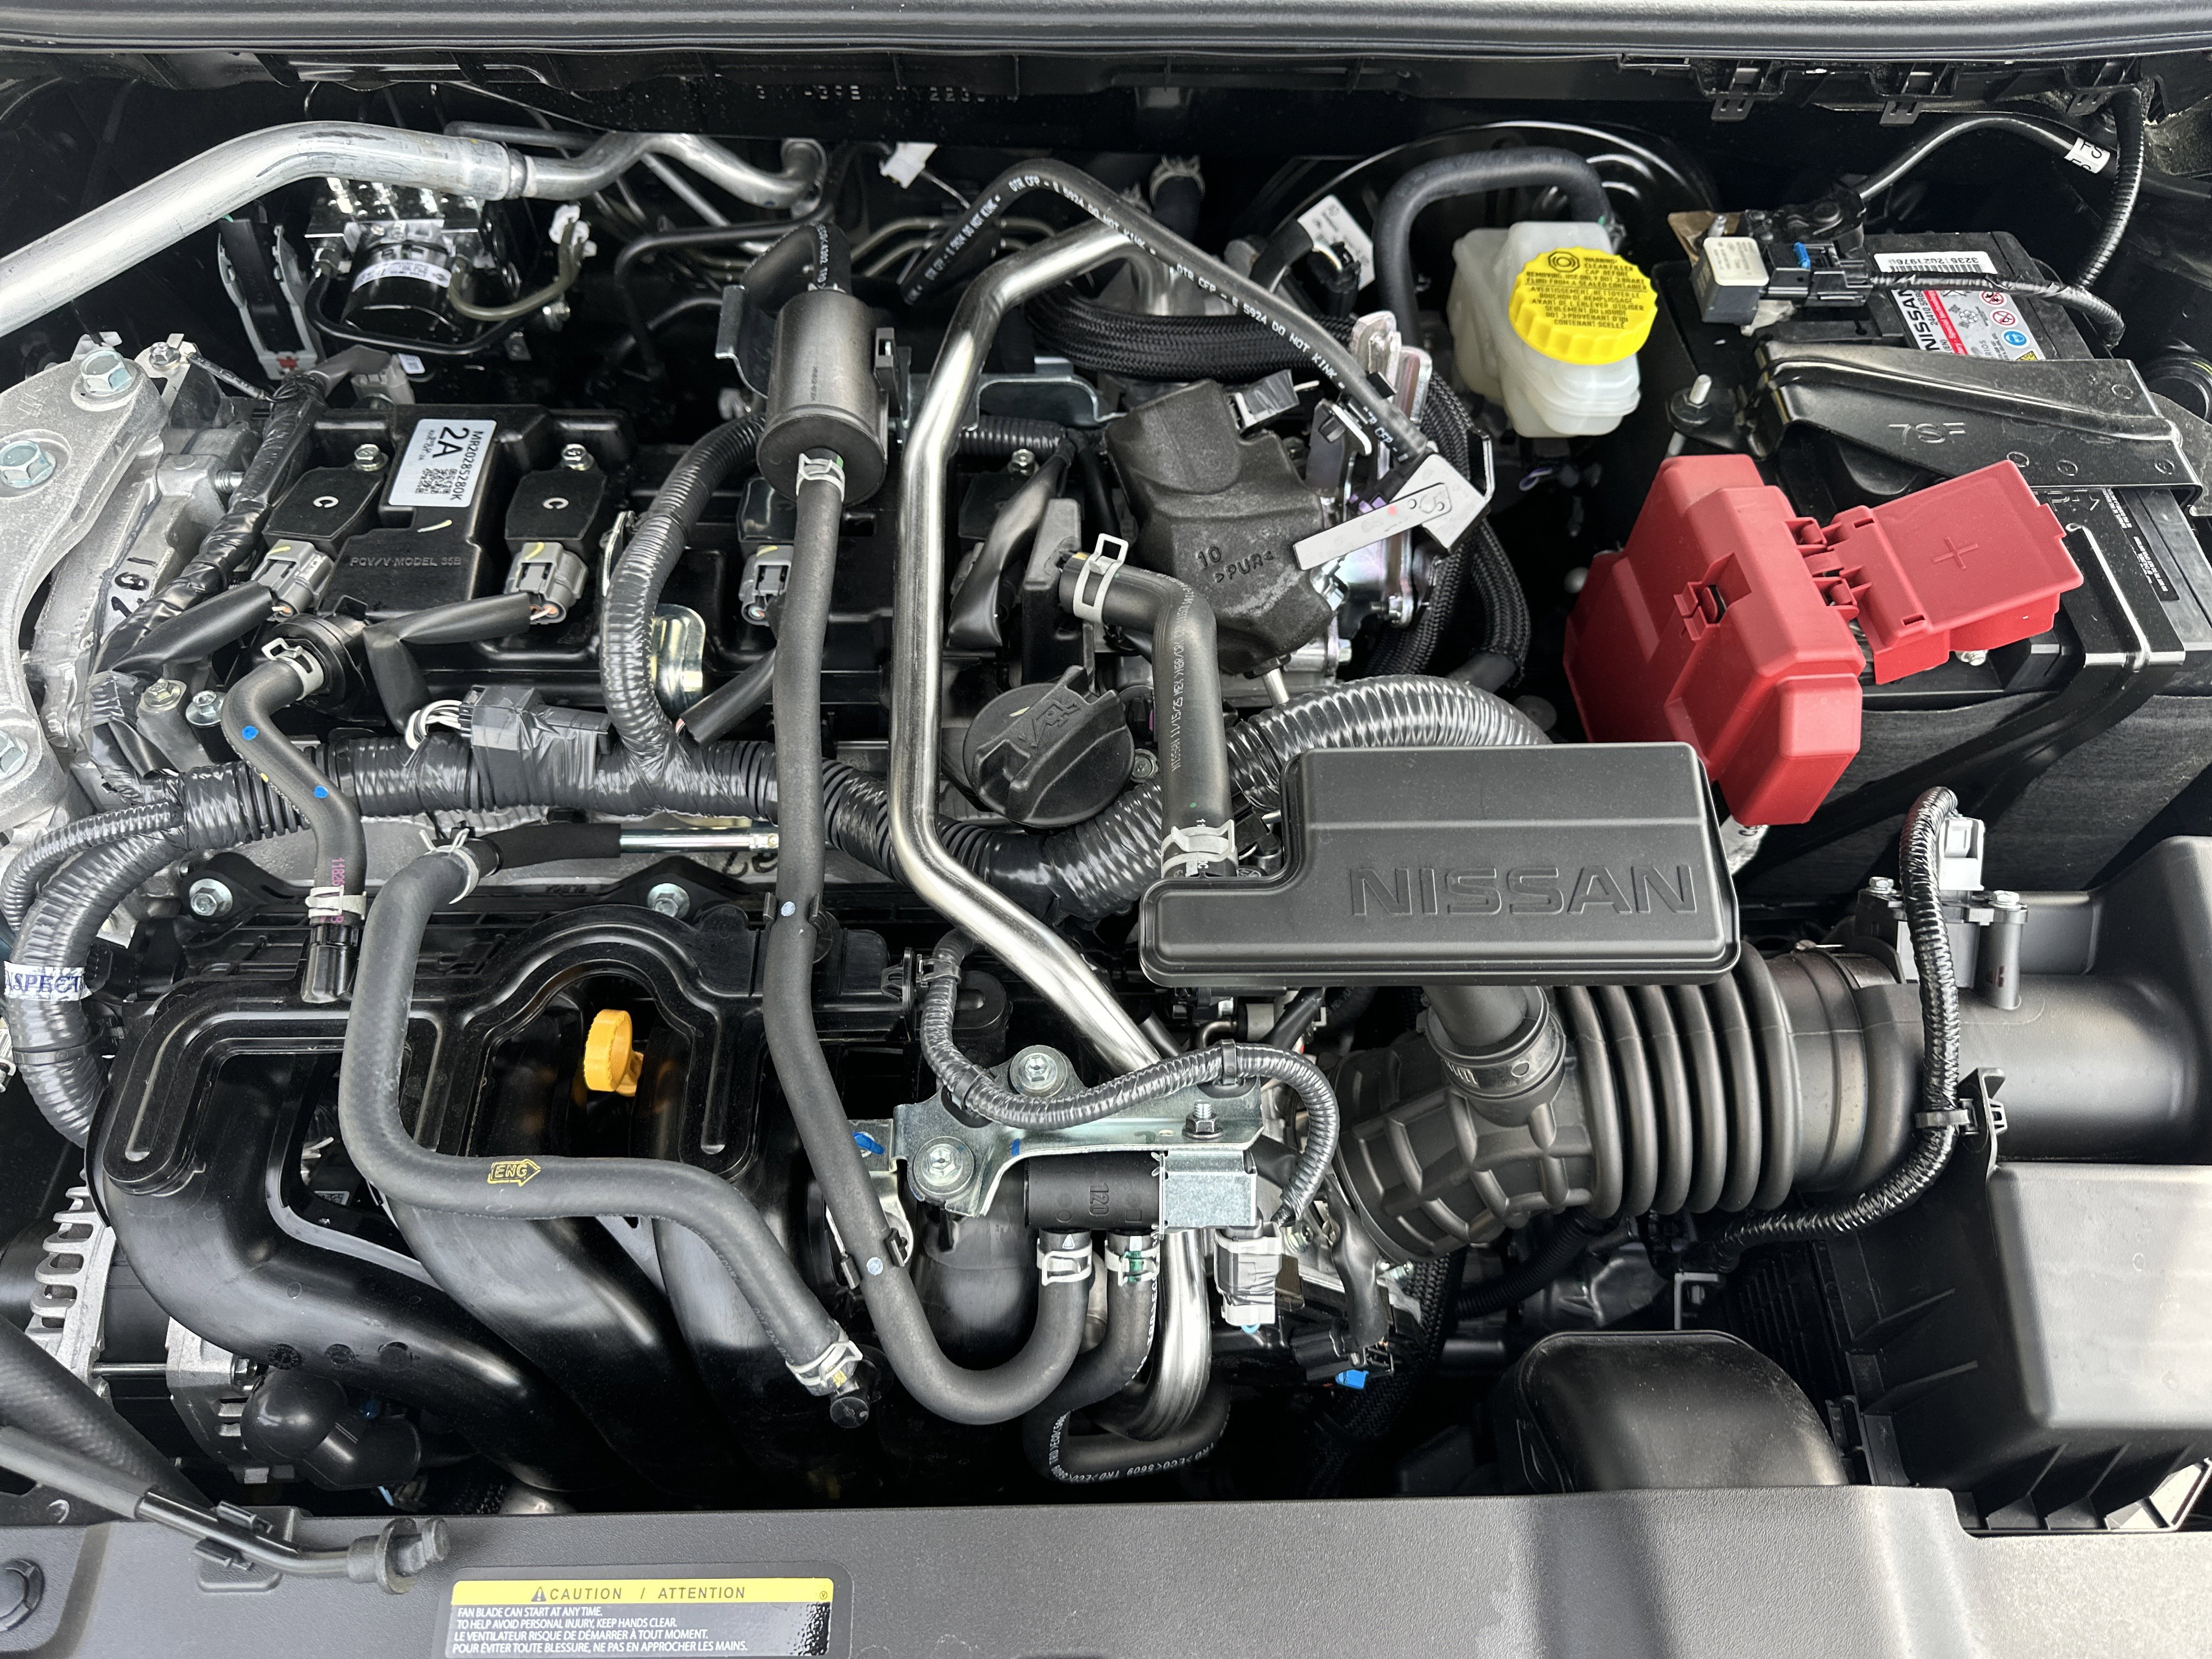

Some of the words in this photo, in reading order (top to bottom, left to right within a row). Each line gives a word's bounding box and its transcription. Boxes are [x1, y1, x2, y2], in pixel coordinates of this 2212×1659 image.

[1289, 332, 1311, 353] NOT
[1312, 353, 1338, 380] KINK
[432, 427, 469, 458] 2A
[450, 431, 484, 500] MR20285280K
[1195, 546, 1222, 567] 10
[1350, 865, 1698, 916] NISSAN
[495, 1164, 527, 1177] ENG
[1089, 1182, 1109, 1216] 120
[550, 1588, 622, 1600] CAUTION
[658, 1587, 745, 1599] ATTENTION
[458, 1607, 475, 1617] FAN
[476, 1607, 503, 1617] BLADE
[504, 1607, 522, 1617] CAN
[524, 1607, 550, 1617] START
[550, 1607, 562, 1616] AT
[563, 1606, 581, 1616] ANY
[580, 1606, 602, 1616] TIME.
[457, 1619, 469, 1629] TO
[470, 1619, 490, 1629] HELP
[492, 1619, 519, 1629] AVOID
[520, 1618, 563, 1629] PERSONAL
[565, 1618, 595, 1629] INJURY,
[597, 1618, 617, 1628] KEEP
[618, 1618, 648, 1628] HANDS
[650, 1618, 677, 1627] CLEAR.
[454, 1632, 465, 1641] LE
[468, 1631, 528, 1641] VENTILATEUR
[528, 1630, 561, 1641] RISQUE
[563, 1630, 576, 1640] DE
[578, 1629, 630, 1640] DÉMARRER
[631, 1629, 636, 1639] À
[639, 1629, 662, 1639] TOUT
[664, 1629, 708, 1639] MOMENT.
[453, 1643, 479, 1654] POUR
[481, 1641, 511, 1653] ÉVITER
[513, 1643, 542, 1652] TOUTE
[544, 1643, 590, 1654] BLESSURE,
[592, 1643, 606, 1652] NE
[608, 1642, 624, 1652] PAS
[627, 1642, 639, 1651] EN
[641, 1641, 696, 1651] APPROCHER
[698, 1641, 714, 1651] LES
[715, 1640, 748, 1651] MAINS.
